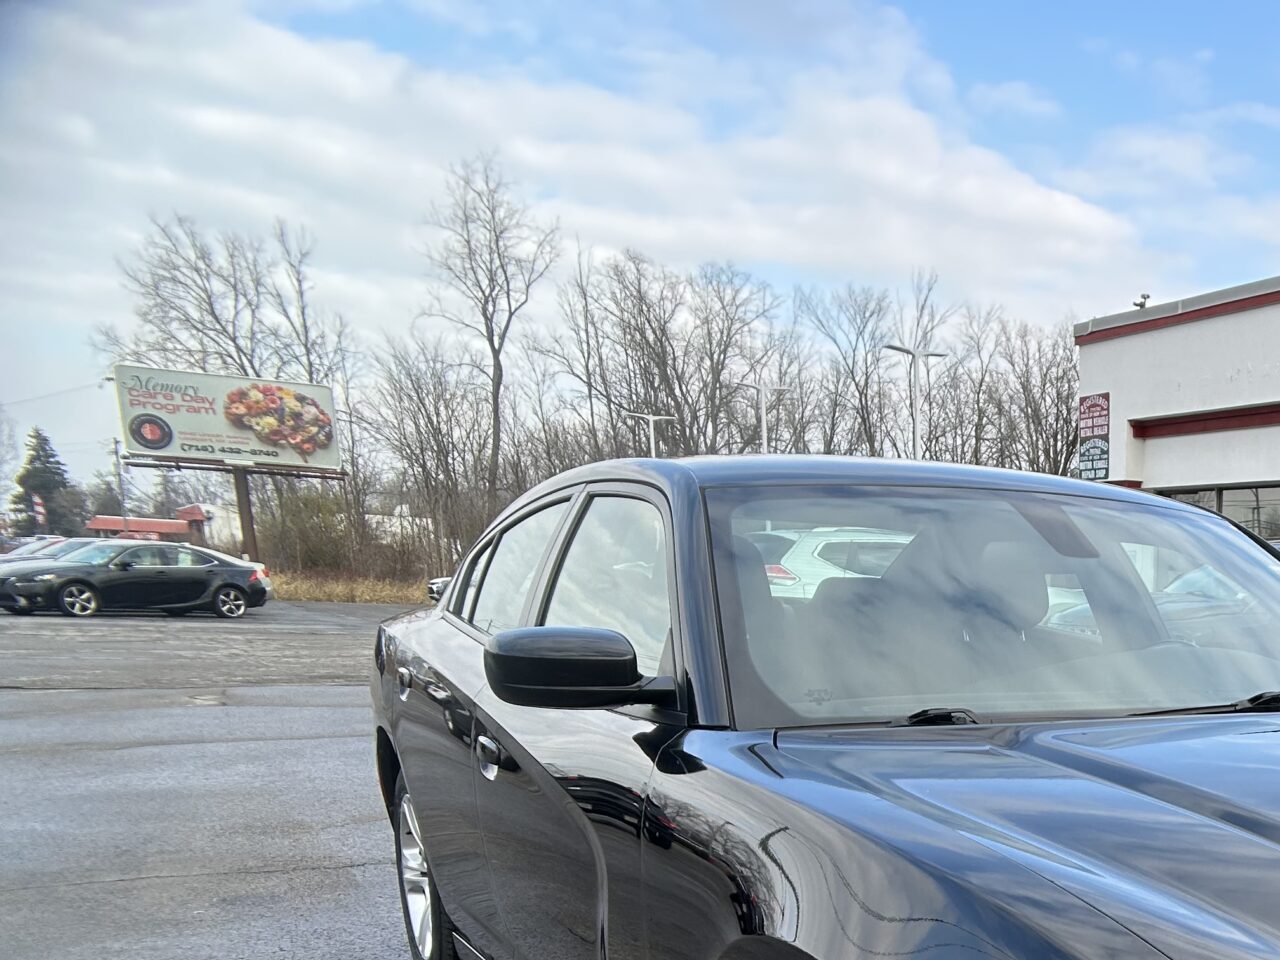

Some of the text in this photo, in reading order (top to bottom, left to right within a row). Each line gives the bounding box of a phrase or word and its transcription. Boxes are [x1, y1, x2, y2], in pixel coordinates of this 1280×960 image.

[121, 374, 200, 395] Memory
[128, 387, 216, 409] Care Day
[128, 398, 217, 415] Program
[1081, 395, 1108, 413] REGISTERED
[1081, 439, 1108, 453] REGISTERED
